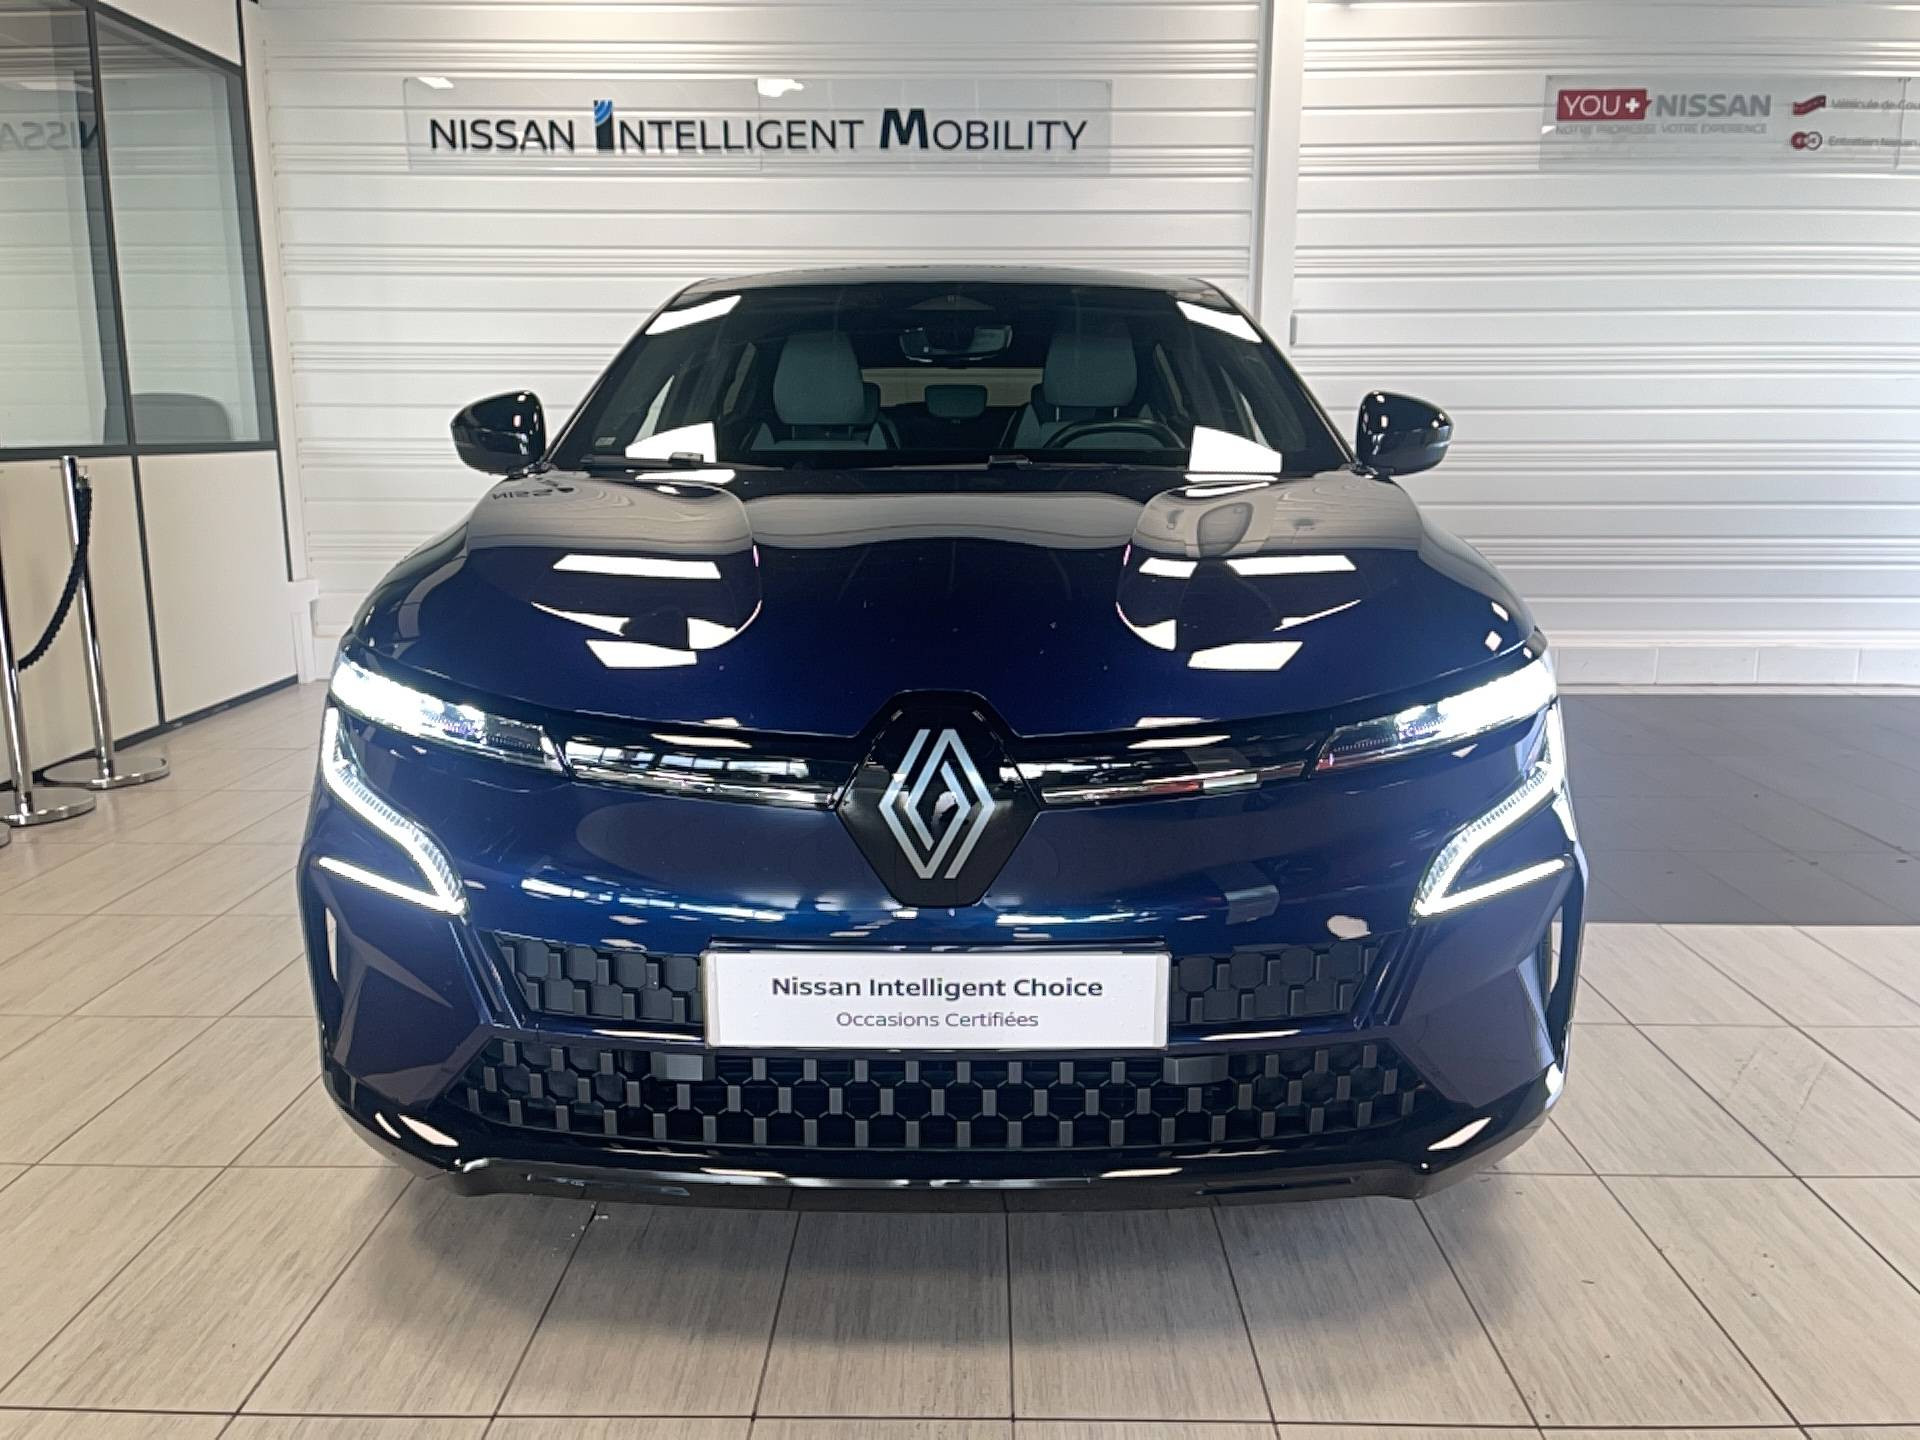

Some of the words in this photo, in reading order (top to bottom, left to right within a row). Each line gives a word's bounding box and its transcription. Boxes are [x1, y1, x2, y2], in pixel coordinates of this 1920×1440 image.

[1655, 94, 1772, 117] NISSAN
[430, 119, 576, 150] NISSAN
[593, 100, 865, 150] INTELLIGENT
[879, 108, 1088, 150] MOBILITY
[772, 977, 861, 996] Nissan
[869, 977, 1007, 1001] Intelligent
[1014, 977, 1104, 996] Choice
[836, 1012, 939, 1027] Occasions
[945, 1011, 1039, 1027] Certifiées
